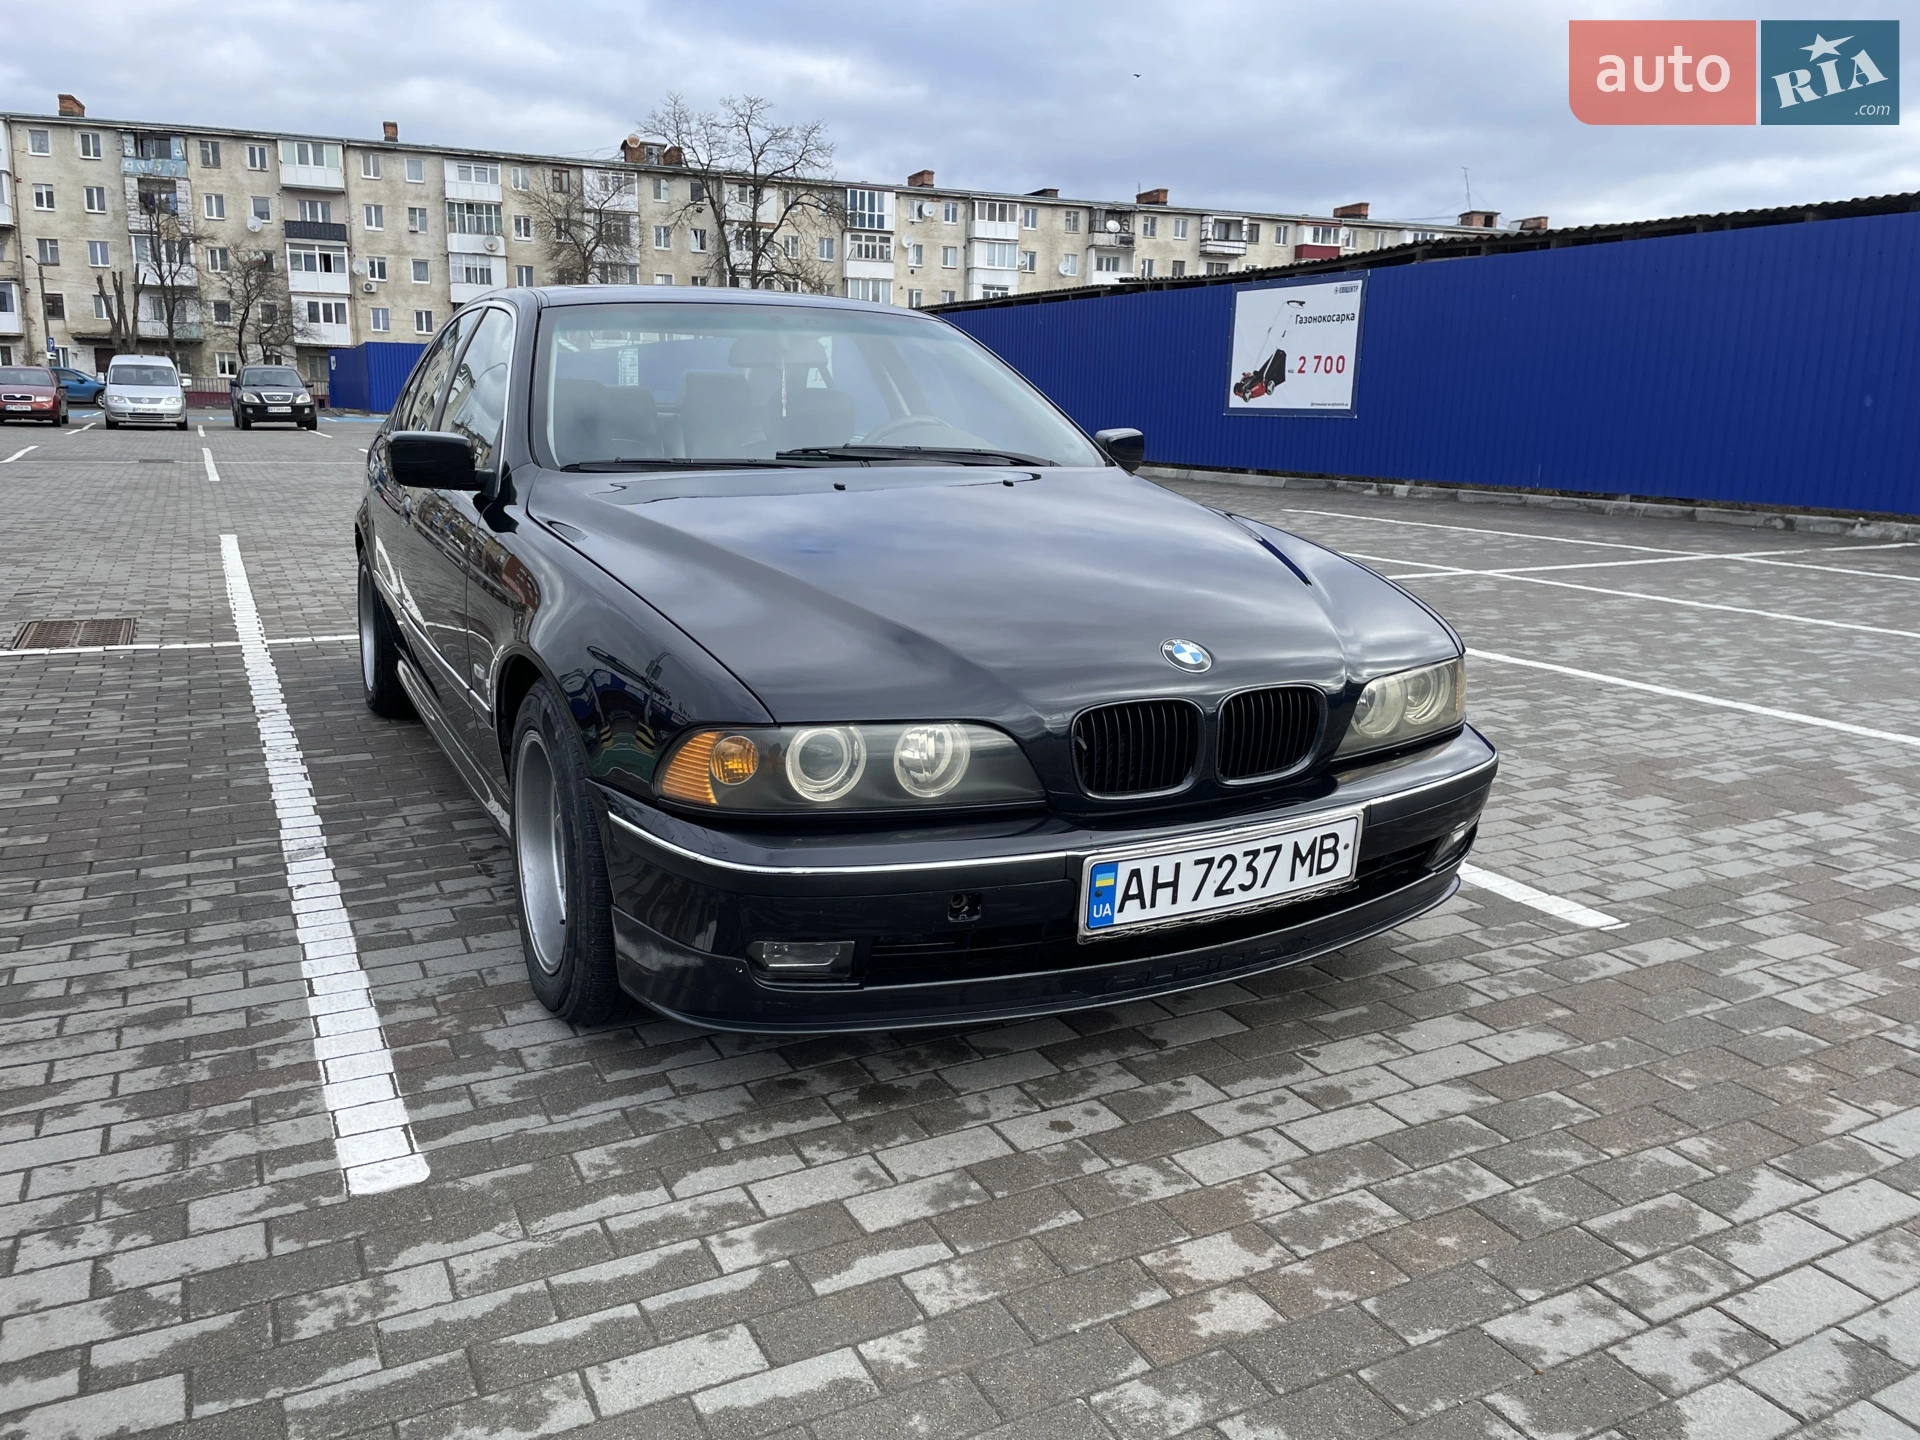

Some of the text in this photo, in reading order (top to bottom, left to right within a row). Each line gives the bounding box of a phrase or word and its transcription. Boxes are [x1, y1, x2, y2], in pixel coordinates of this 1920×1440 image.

[1295, 312, 1356, 325] Газонокосарка
[1297, 356, 1307, 374] 2
[1313, 355, 1346, 374] 700
[1117, 832, 1340, 914] AH 7237 MB
[1093, 903, 1112, 919] UA
